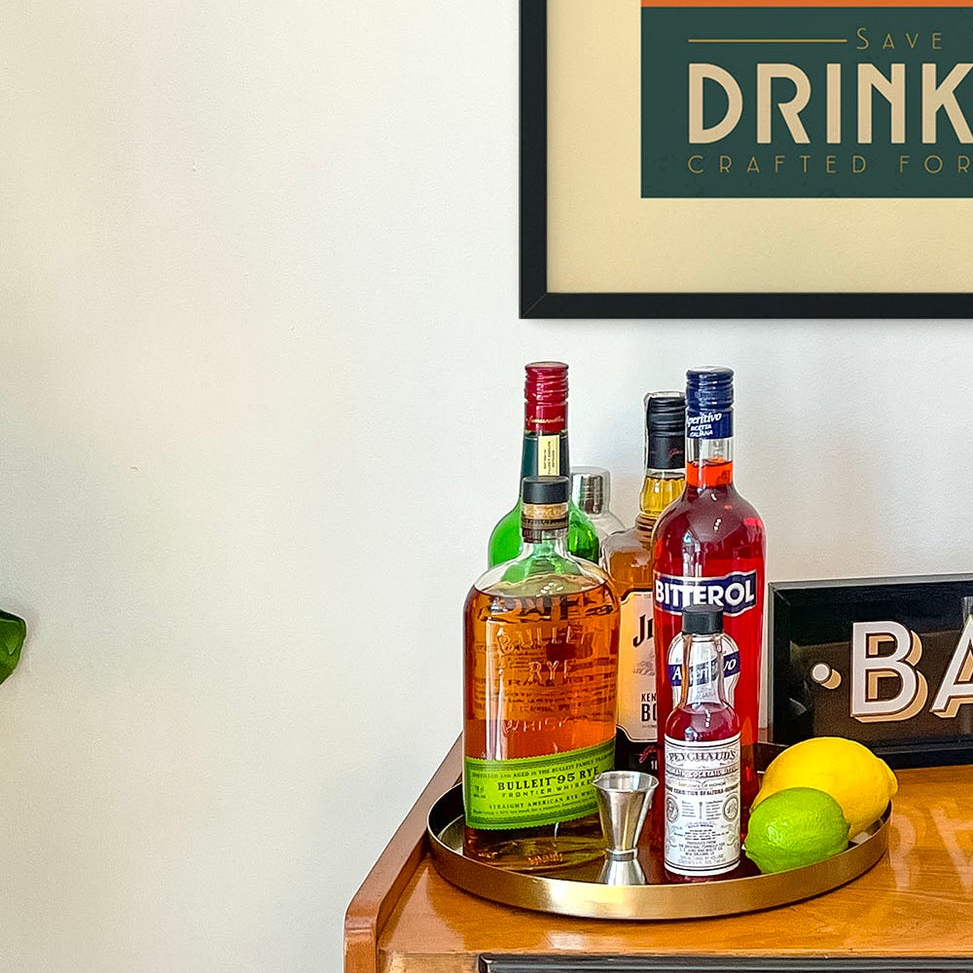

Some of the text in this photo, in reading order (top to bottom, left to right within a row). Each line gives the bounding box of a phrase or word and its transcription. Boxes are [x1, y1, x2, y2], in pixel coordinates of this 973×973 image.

[688, 155, 867, 174] CRAFTED
[900, 155, 971, 174] FOR
[687, 412, 722, 427] peritivo
[655, 579, 755, 607] BITTEROL
[497, 777, 552, 792] BULLEIT
[557, 773, 576, 785] 95
[579, 766, 600, 780] RYE
[502, 779, 593, 798] FRONTIER WHISKE
[489, 802, 525, 810] STRAIGHT
[527, 797, 564, 808] AMERICAN
